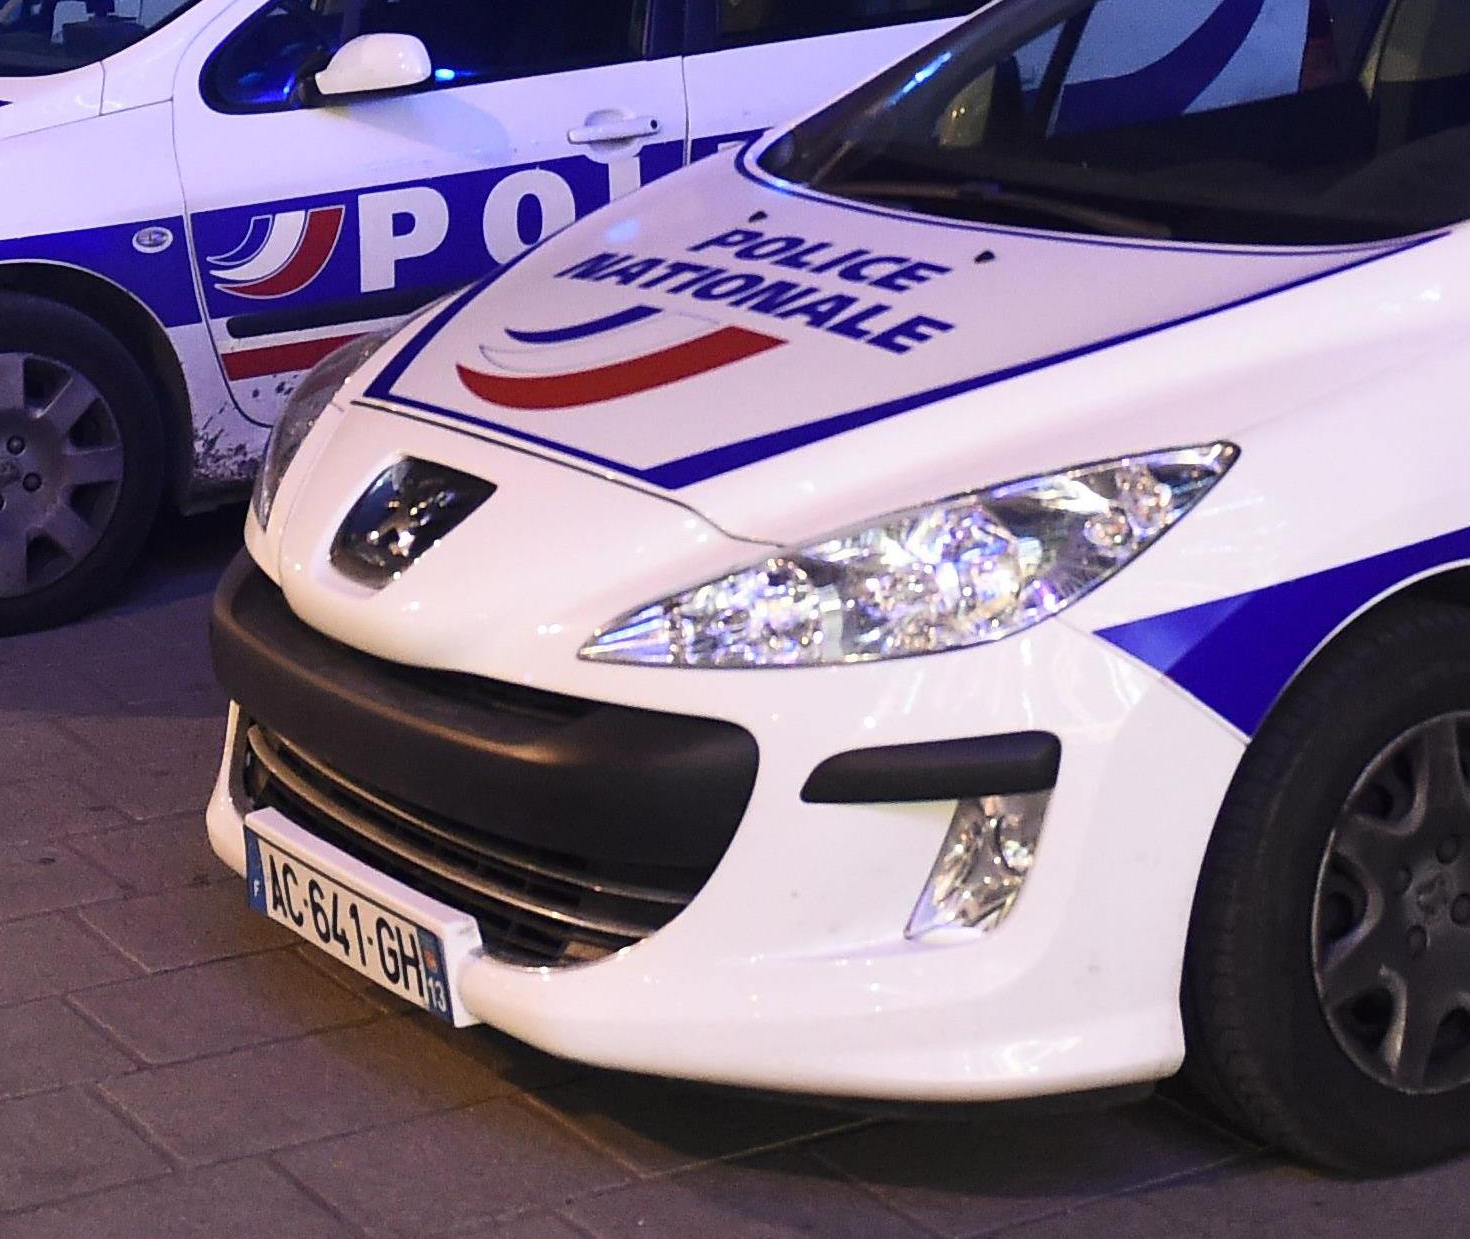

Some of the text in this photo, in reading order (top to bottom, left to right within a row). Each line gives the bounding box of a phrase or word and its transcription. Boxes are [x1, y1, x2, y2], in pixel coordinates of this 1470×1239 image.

[686, 228, 953, 292] POLICE
[554, 252, 957, 355] NATIONALE
[427, 976, 447, 1012] 13
